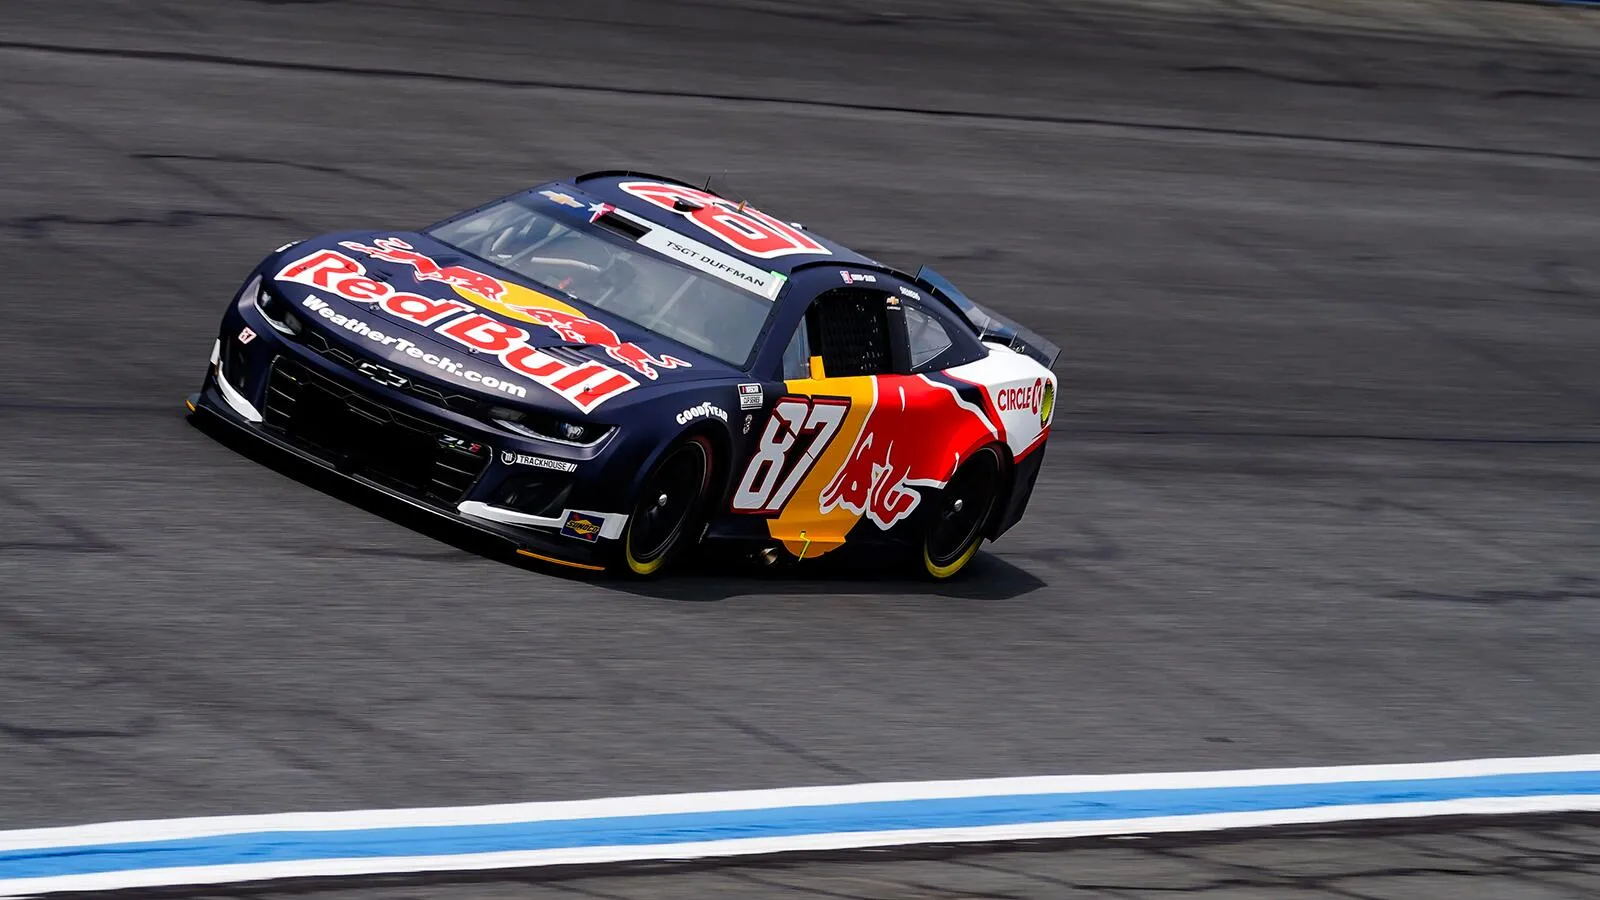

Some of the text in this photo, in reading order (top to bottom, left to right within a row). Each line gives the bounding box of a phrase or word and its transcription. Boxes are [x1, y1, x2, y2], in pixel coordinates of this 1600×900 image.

[667, 240, 765, 287] TSGT DUFFMAN
[274, 249, 641, 416] Red Bull
[302, 294, 527, 398] WeatherTech.com
[676, 401, 728, 425] GOODYEAR
[997, 387, 1032, 412] CIRCLE
[518, 455, 568, 471] TRACKHOUSE
[731, 397, 850, 513] 87
[566, 519, 600, 533] SUNOCO
